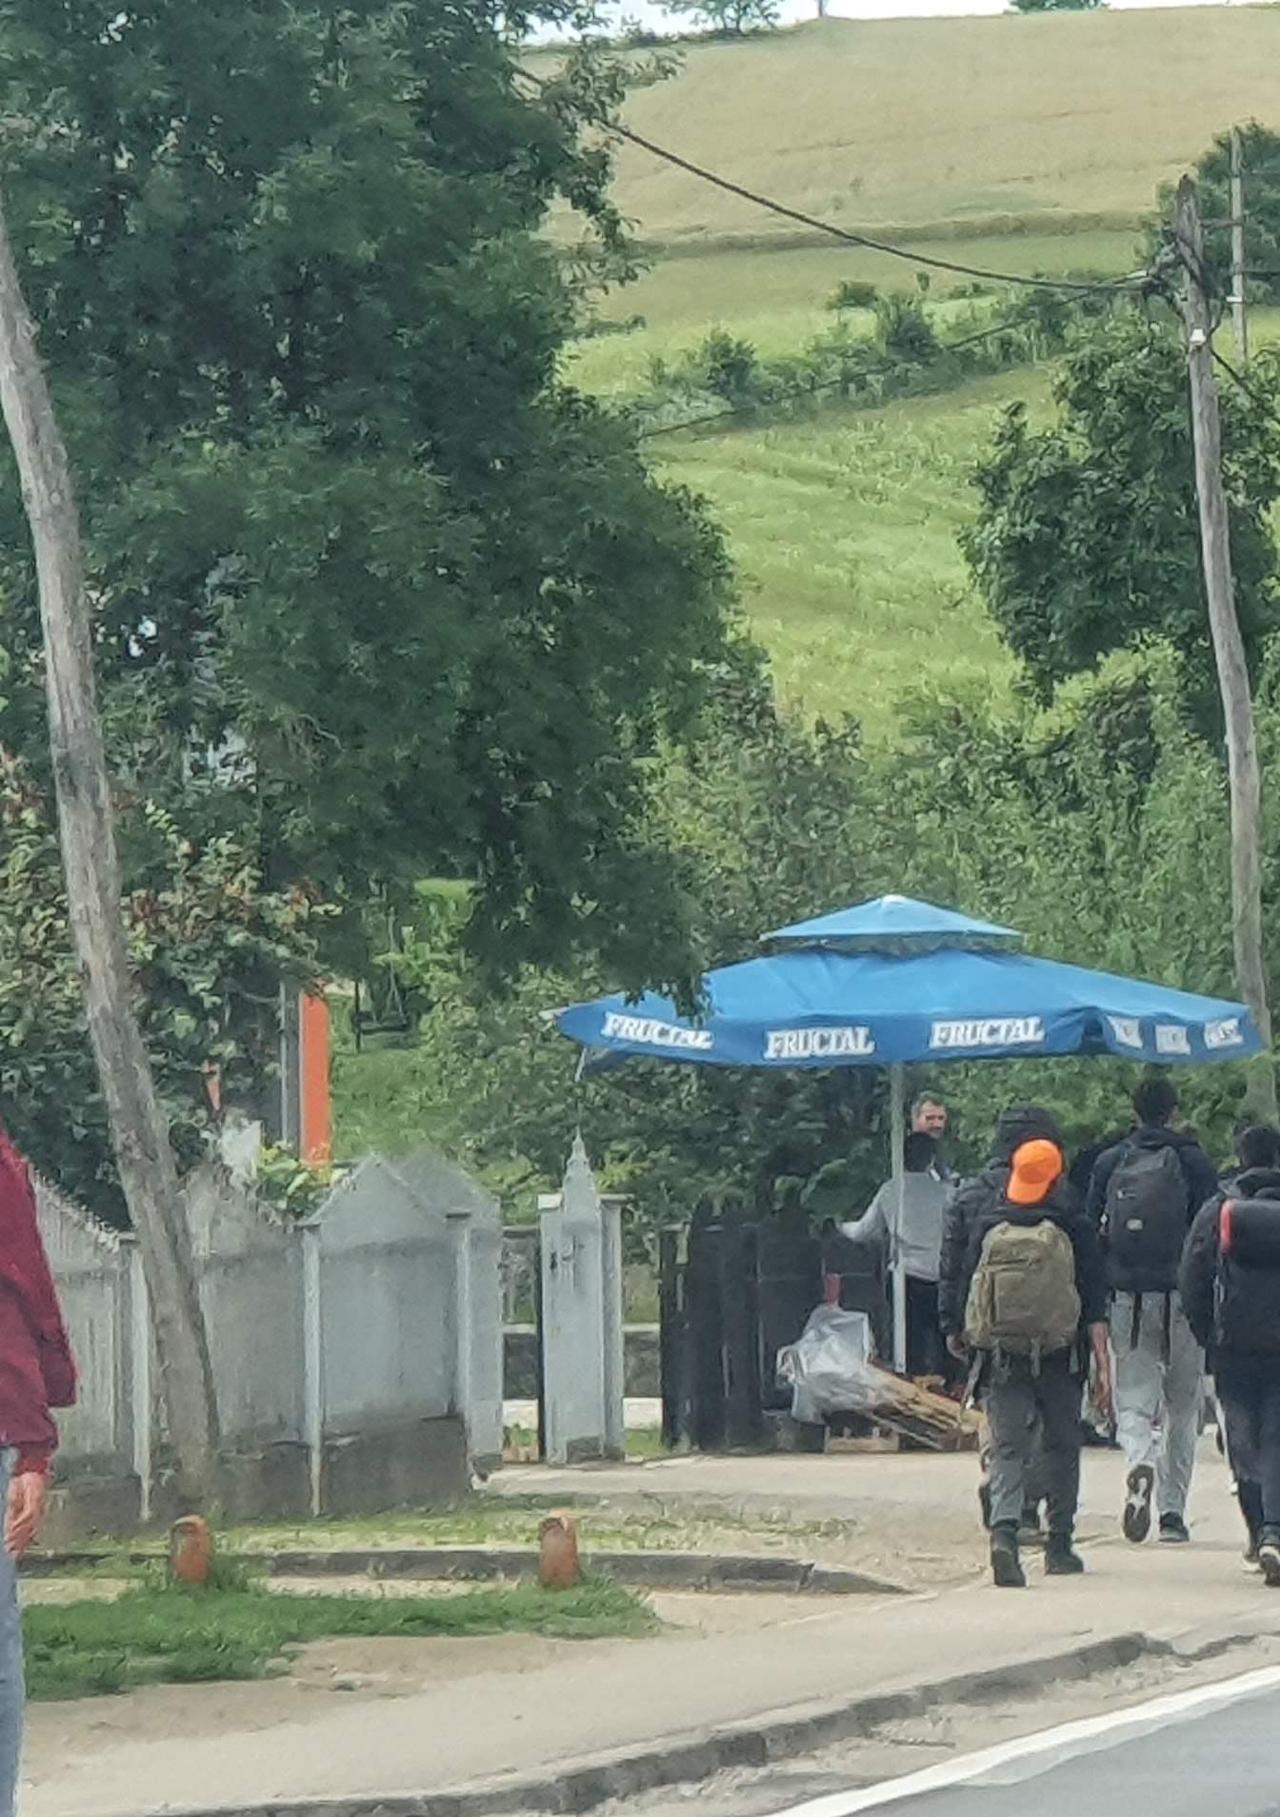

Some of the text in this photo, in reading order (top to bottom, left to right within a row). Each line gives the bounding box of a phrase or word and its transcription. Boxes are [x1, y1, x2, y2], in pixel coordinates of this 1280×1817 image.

[601, 1012, 713, 1049] FRUCTAL
[764, 1027, 875, 1059] FRUCTAL
[930, 1016, 1046, 1048] FRUCTAL
